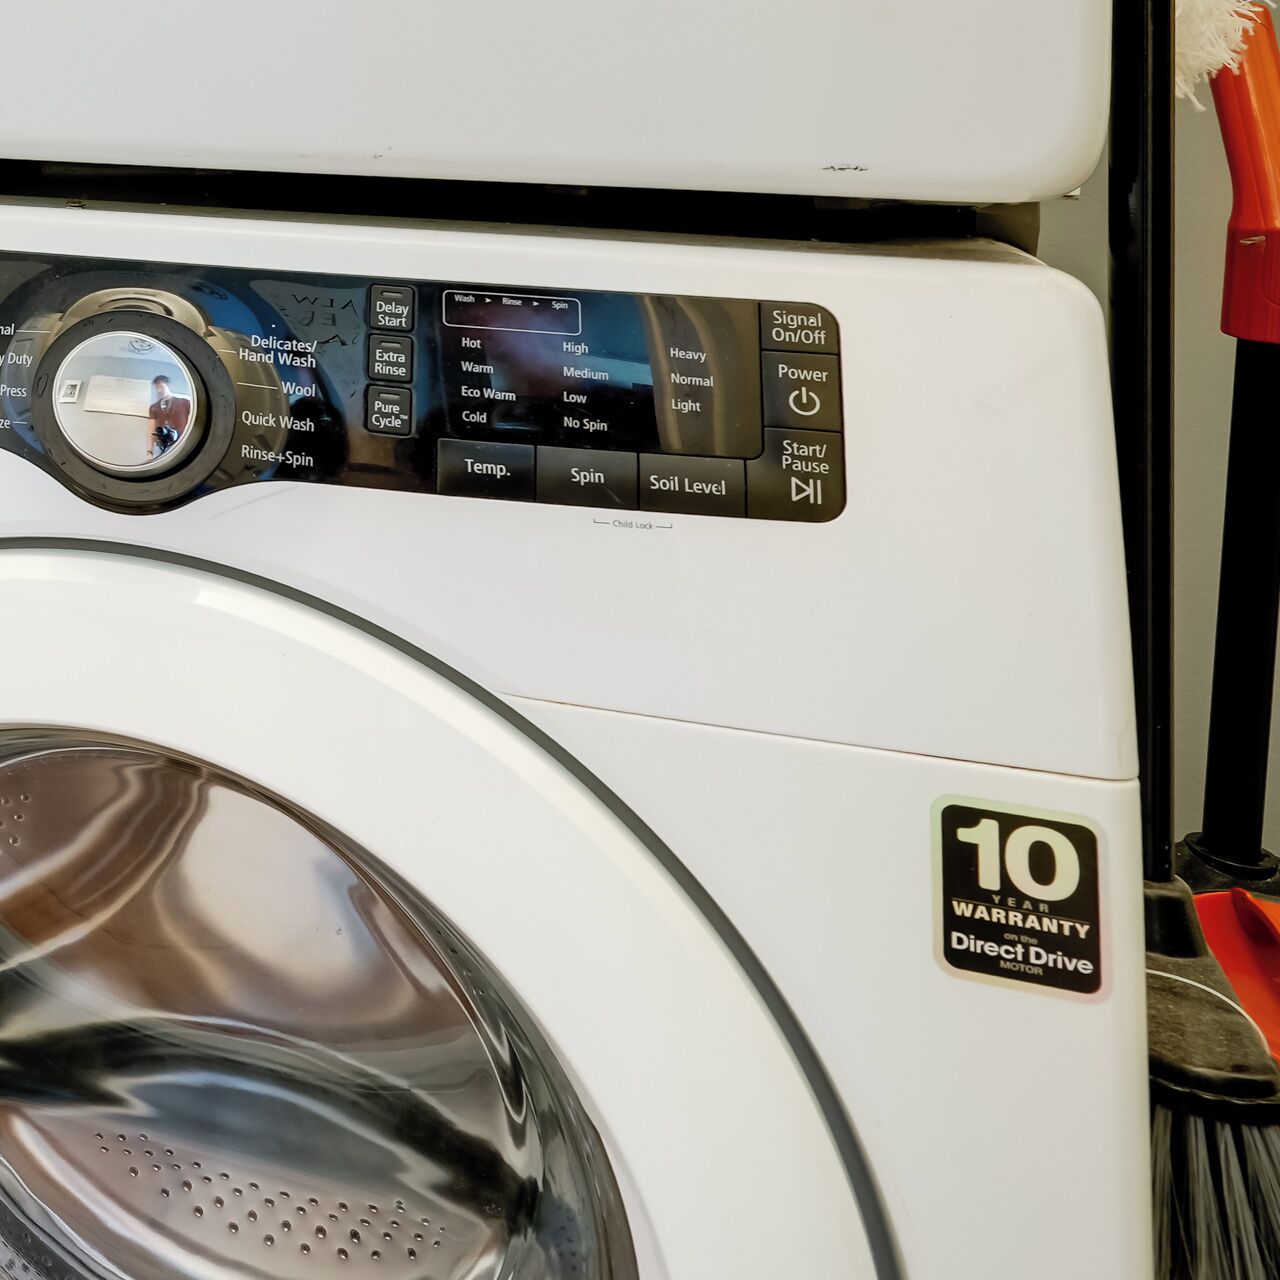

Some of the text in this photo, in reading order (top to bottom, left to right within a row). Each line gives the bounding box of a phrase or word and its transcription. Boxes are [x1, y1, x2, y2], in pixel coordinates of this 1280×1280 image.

[376, 301, 409, 317] Delay
[454, 294, 568, 309] Wash Rinse Spin
[378, 314, 407, 327] Start
[772, 310, 821, 329] Signal
[462, 337, 481, 349] Hot
[772, 327, 826, 344] On/Off
[251, 335, 317, 353] Delicates/
[563, 342, 589, 356] High
[8, 352, 33, 368] Duty
[239, 348, 316, 368] Hand Wash
[375, 349, 405, 363] Extra
[670, 347, 706, 363] Heavy
[375, 363, 406, 376] Rinse
[461, 361, 493, 374] Warm
[563, 367, 609, 381] Medium
[778, 364, 828, 382] Power
[671, 373, 713, 387] Normal
[0, 385, 27, 398] Press
[281, 381, 316, 397] Wool
[461, 386, 516, 401] Eco Warm
[564, 392, 587, 404] Low
[672, 399, 701, 413] Light
[374, 401, 400, 414] Pure
[241, 411, 315, 432] Quick Wash
[462, 411, 487, 423] Cold
[564, 416, 608, 432] No Spin
[241, 445, 314, 468] Rinse+Spin
[783, 440, 827, 458] Start/
[464, 458, 511, 478] Temp.
[782, 455, 829, 474] Pause
[571, 467, 605, 486] Spin
[649, 475, 726, 495] Soil Level
[613, 519, 653, 530] Child Lock
[956, 818, 1080, 901] 10
[992, 894, 1049, 913] YEAR
[952, 900, 1090, 940] WARRANTY
[1004, 932, 1038, 945] on the
[951, 931, 1093, 974] Direct Drive
[999, 960, 1043, 976] MOTOR
